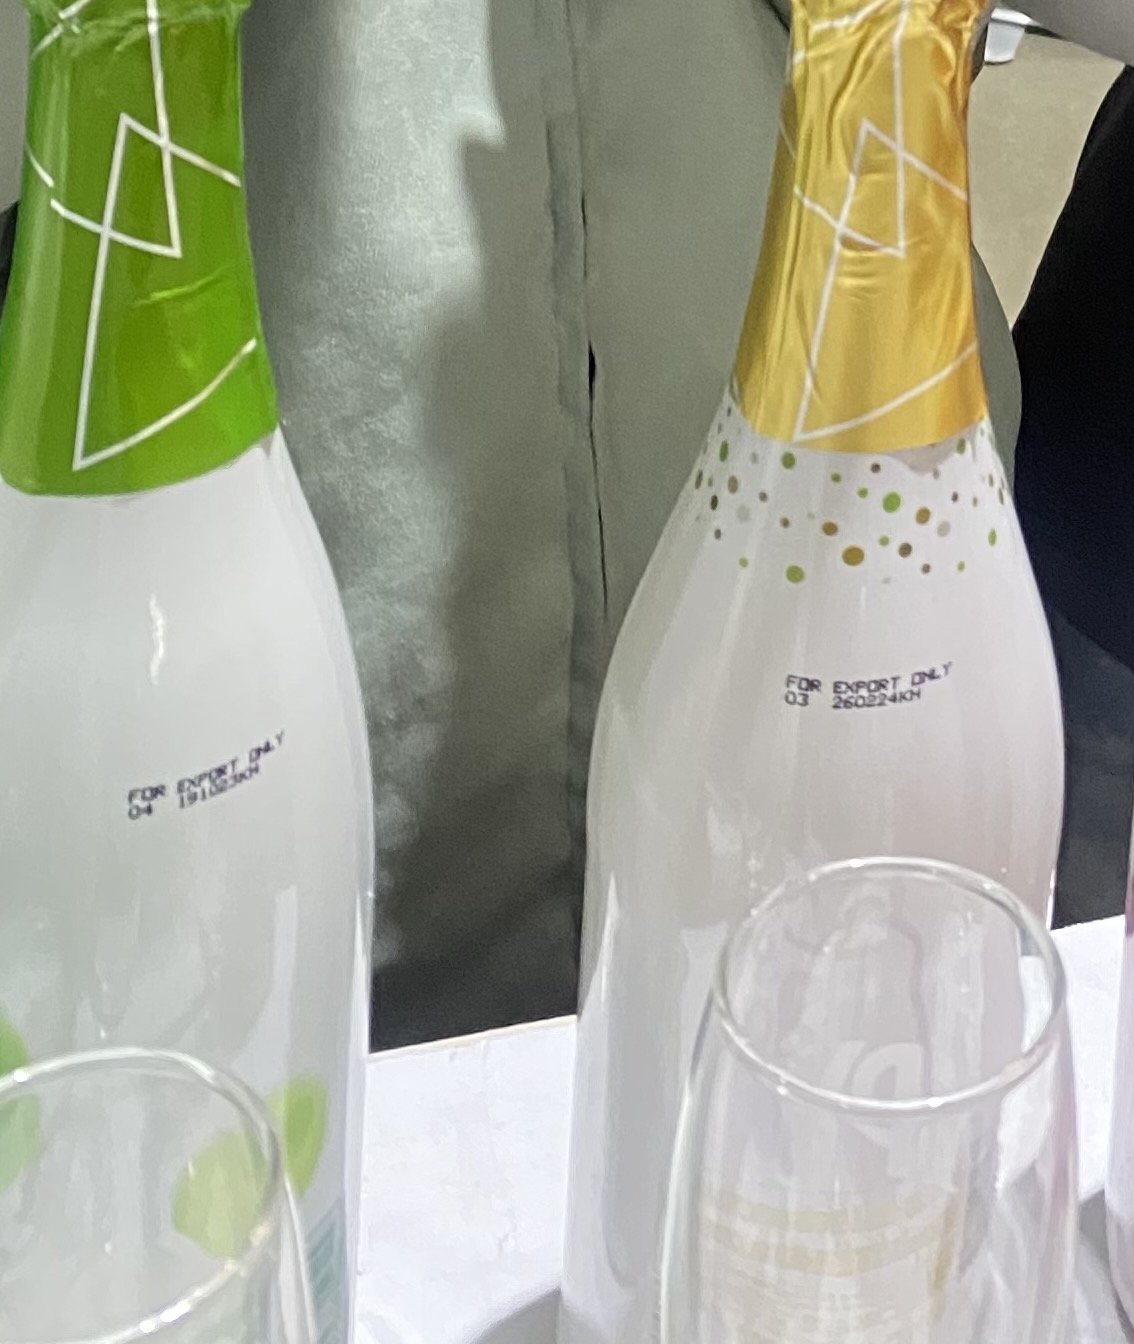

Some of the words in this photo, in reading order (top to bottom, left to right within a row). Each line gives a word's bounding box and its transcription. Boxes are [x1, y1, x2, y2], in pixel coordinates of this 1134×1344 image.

[785, 673, 822, 693] FOR
[832, 676, 901, 695] EXPORT
[911, 661, 953, 687] ONLY
[784, 690, 809, 708] 03
[127, 783, 166, 805] FOR
[177, 756, 239, 794] EXPORT
[248, 728, 285, 763] ONLY
